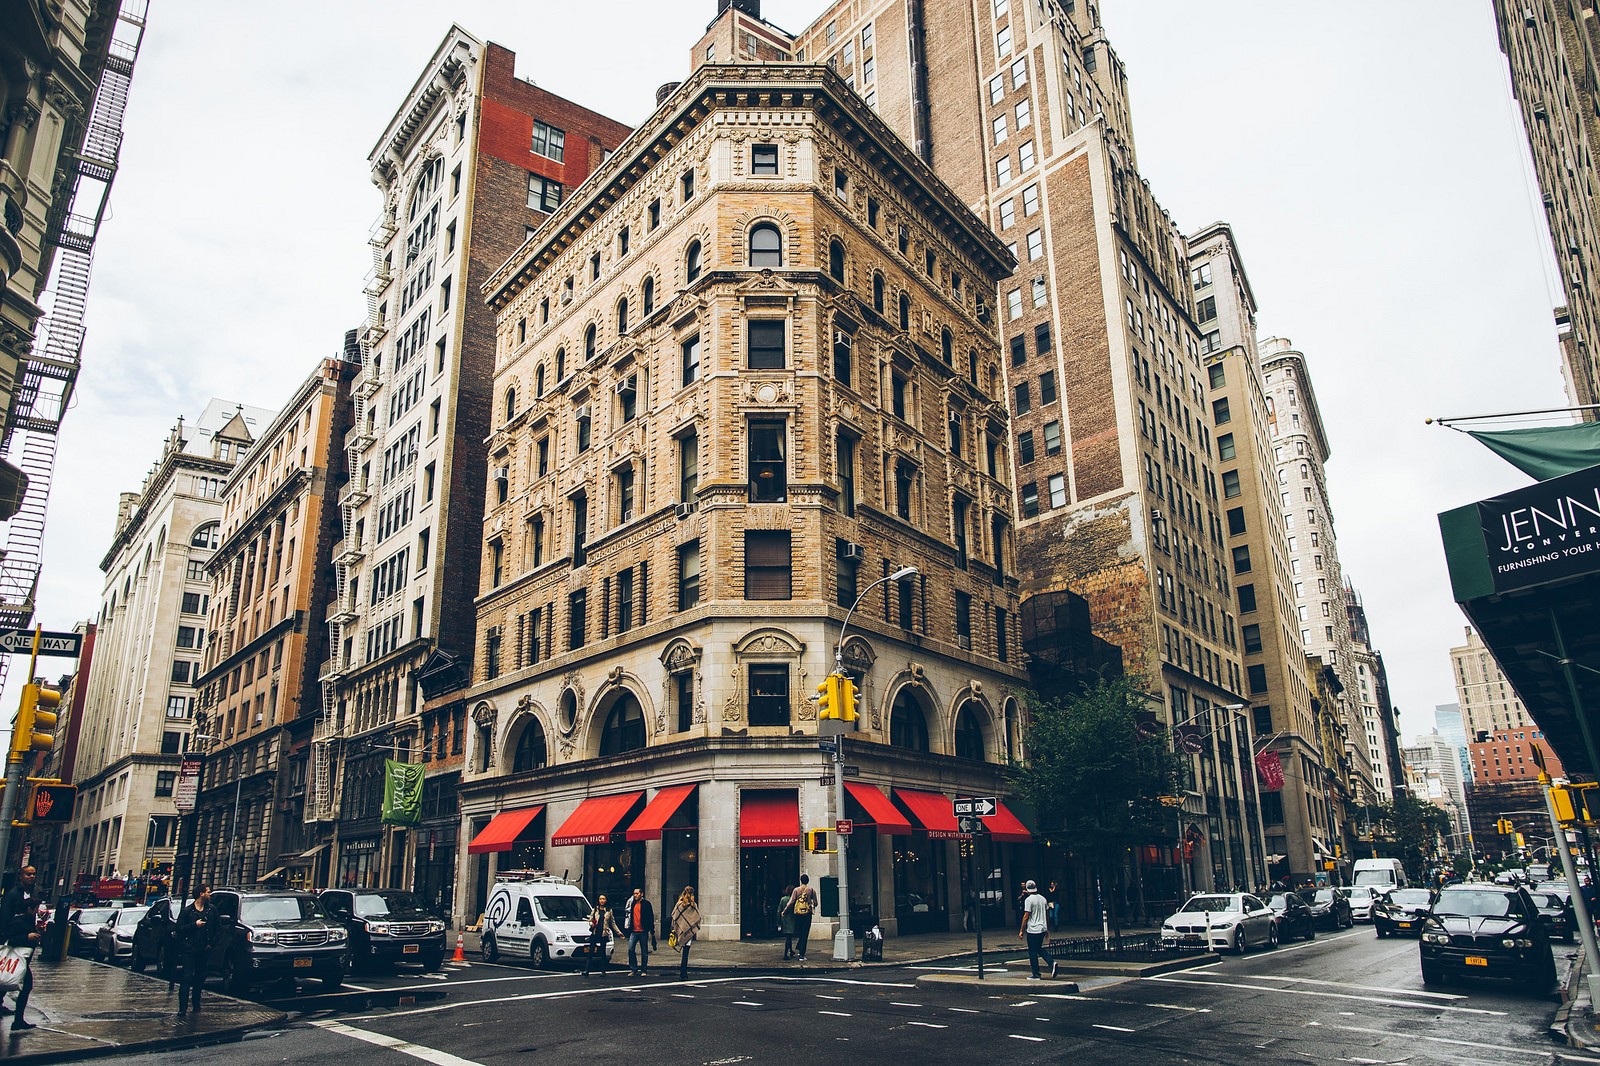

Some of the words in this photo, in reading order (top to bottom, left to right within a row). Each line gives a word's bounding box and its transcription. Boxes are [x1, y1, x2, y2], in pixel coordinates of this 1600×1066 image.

[1497, 551, 1559, 573] FURNISHING
[1562, 543, 1593, 557] YOUR
[4, 635, 31, 647] ONE
[43, 638, 71, 650] WAY
[957, 804, 969, 812] ONE
[554, 837, 571, 846] DESIGN
[572, 836, 589, 844] WITHIN
[590, 835, 606, 843] REACH
[928, 831, 947, 839] DESIGN
